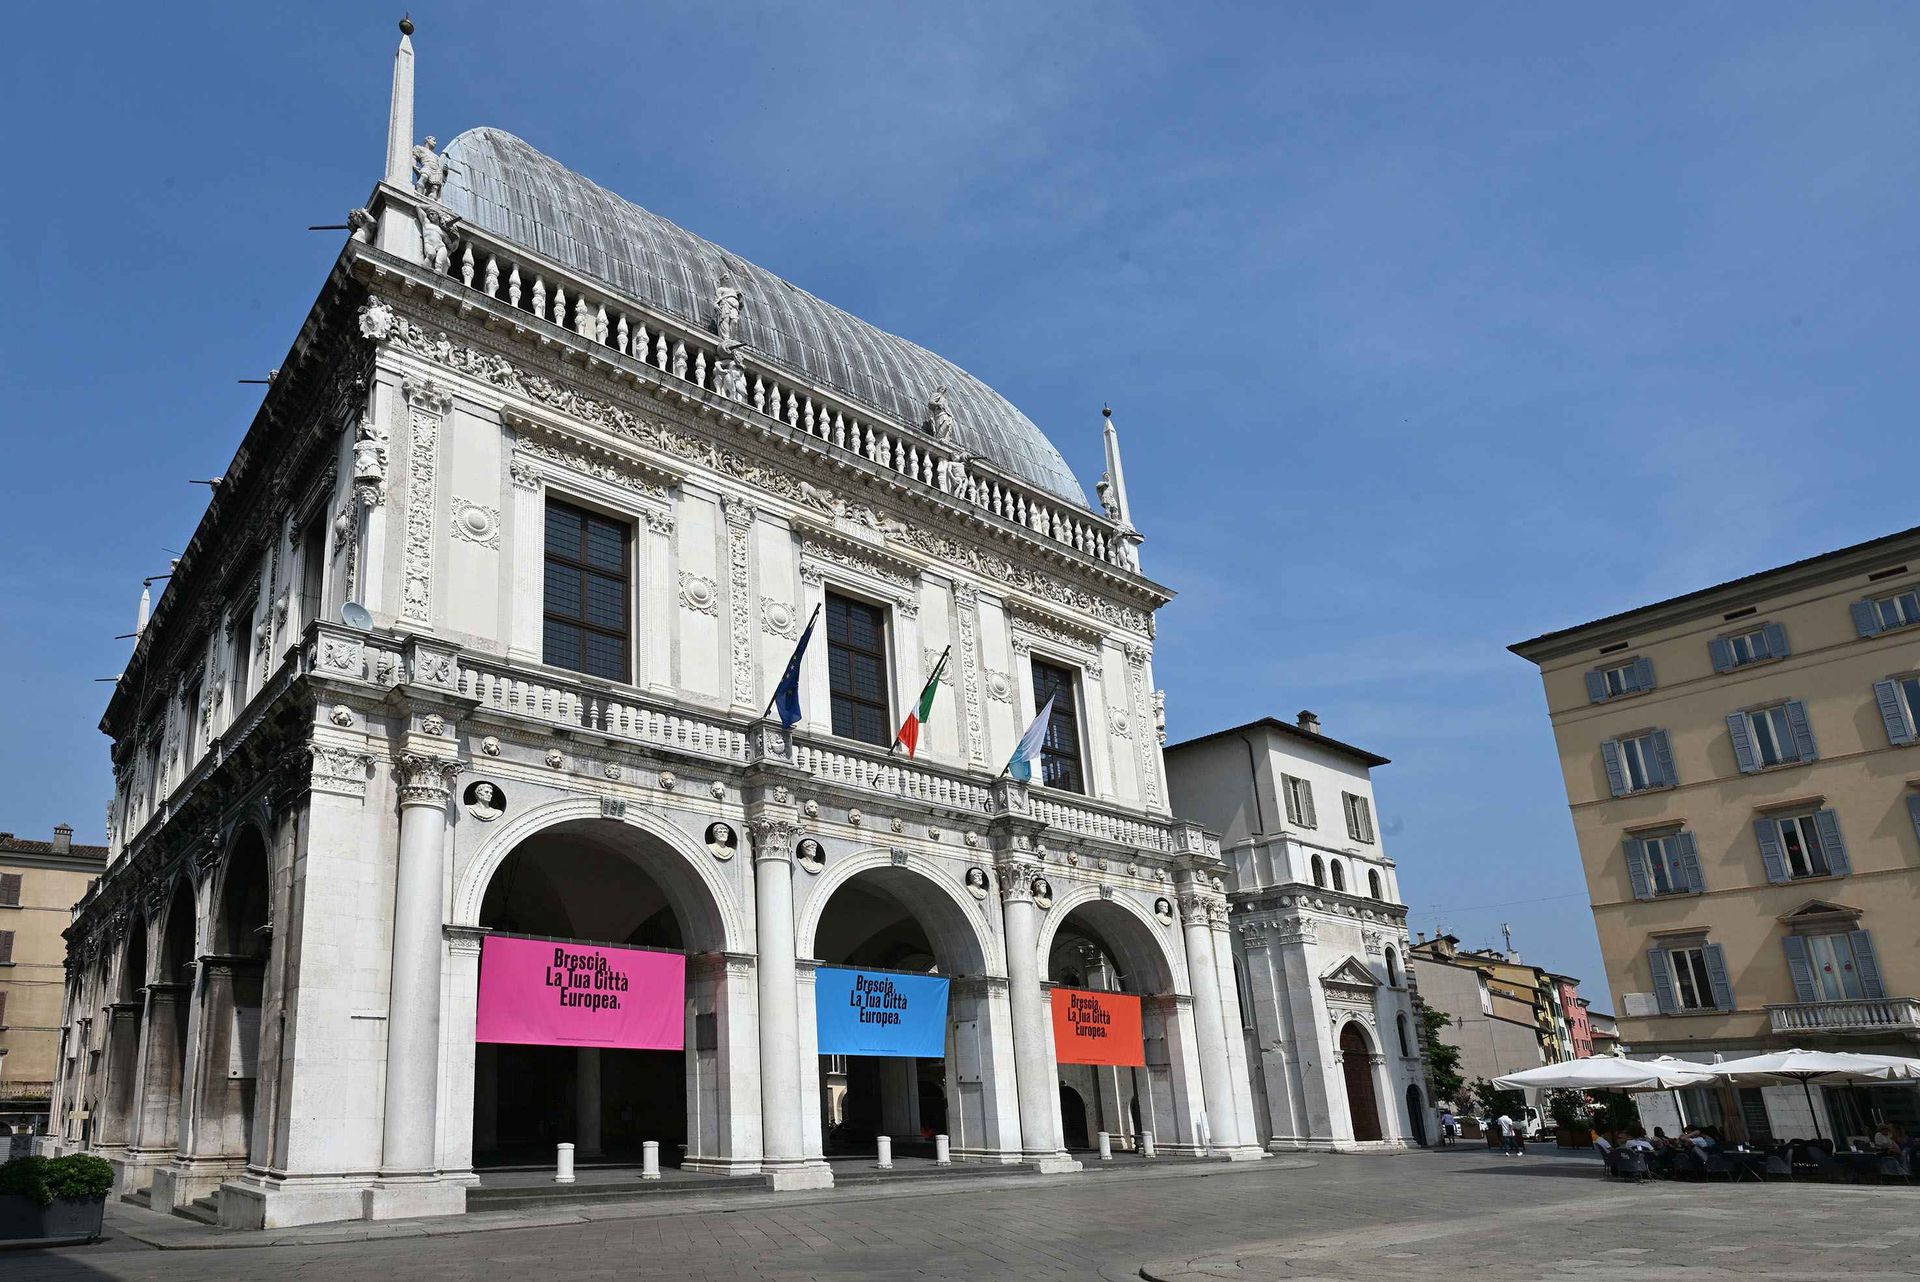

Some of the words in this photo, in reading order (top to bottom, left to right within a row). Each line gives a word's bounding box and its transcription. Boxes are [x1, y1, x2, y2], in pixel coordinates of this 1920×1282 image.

[546, 966, 563, 987] La
[567, 968, 591, 989] Tua
[594, 970, 629, 992] Città
[560, 987, 621, 1012] Europea.
[850, 990, 862, 1007] La
[865, 991, 881, 1008] Tua
[883, 993, 908, 1010] Città
[860, 1006, 901, 1028] Europea.
[1068, 1007, 1077, 1022] La
[1078, 1008, 1091, 1023] Tua
[1092, 1009, 1111, 1025] Città
